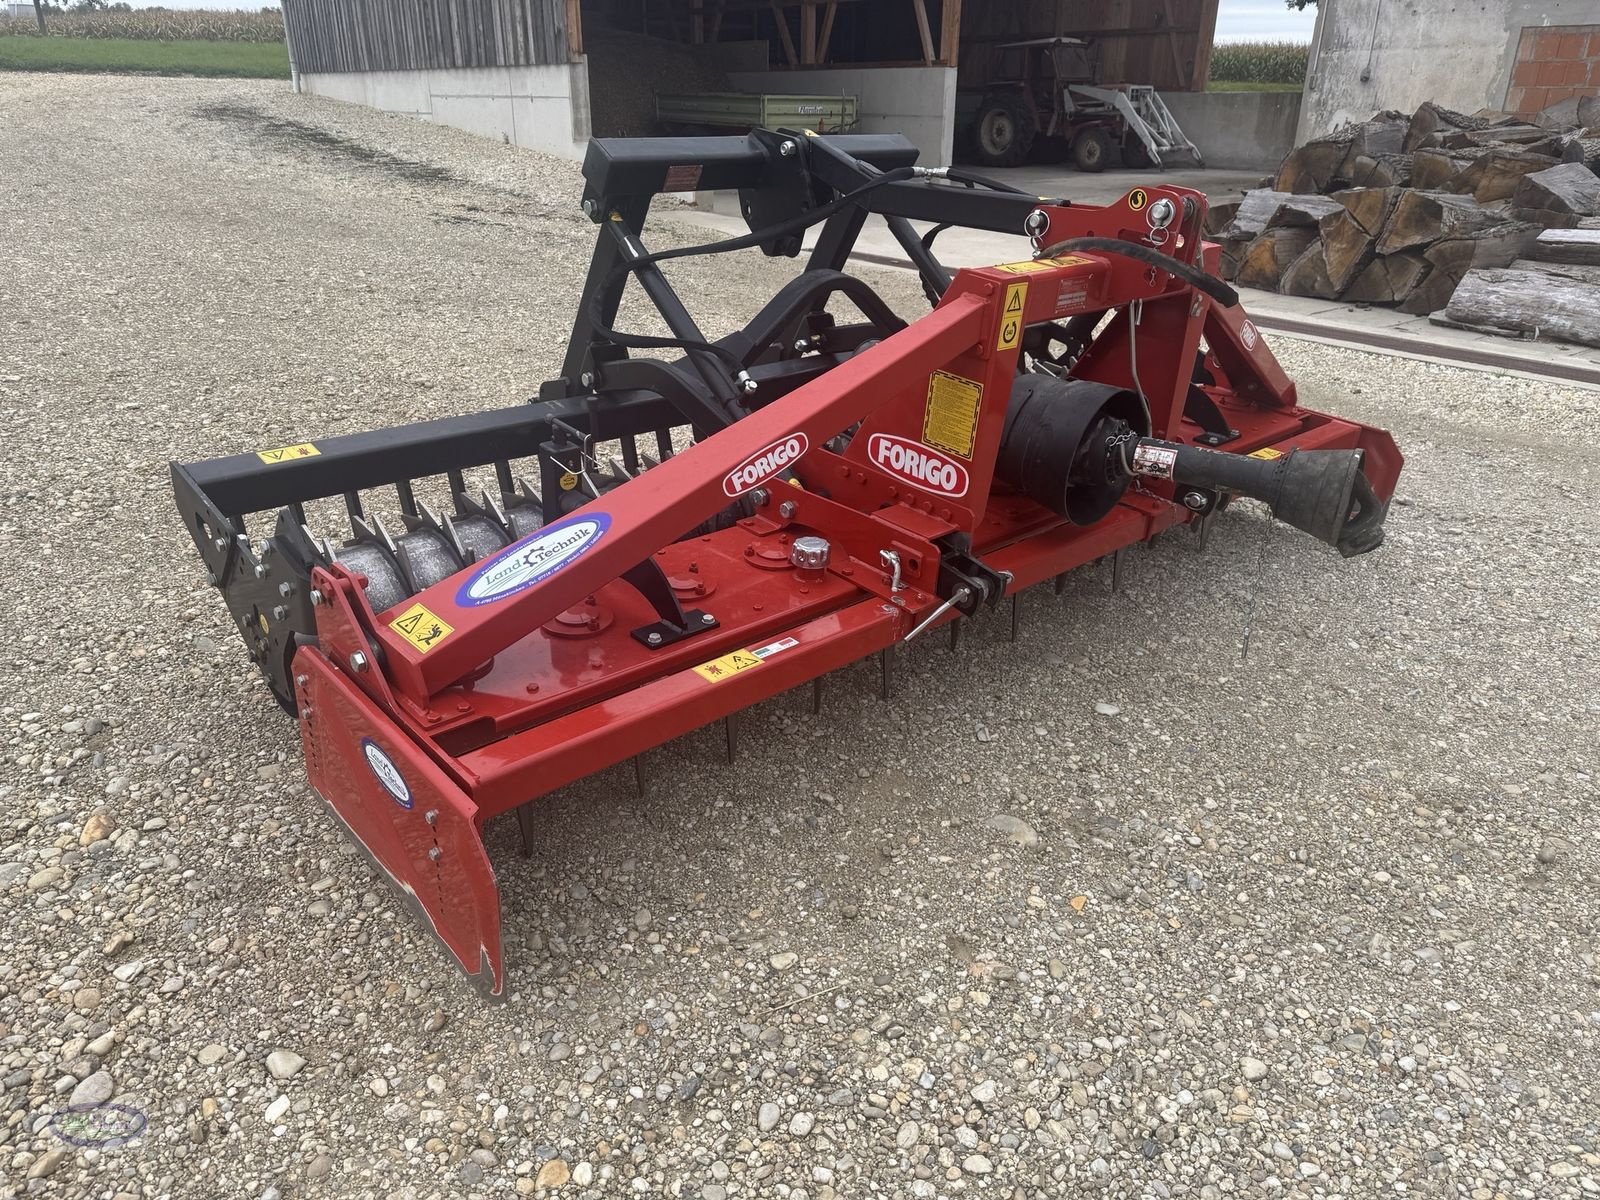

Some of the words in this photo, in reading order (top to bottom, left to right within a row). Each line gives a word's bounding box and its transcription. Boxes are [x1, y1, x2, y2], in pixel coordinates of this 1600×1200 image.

[731, 438, 799, 492] FORIGO
[878, 438, 957, 491] FORIGO
[485, 559, 523, 586] Land
[535, 528, 592, 565] Technik
